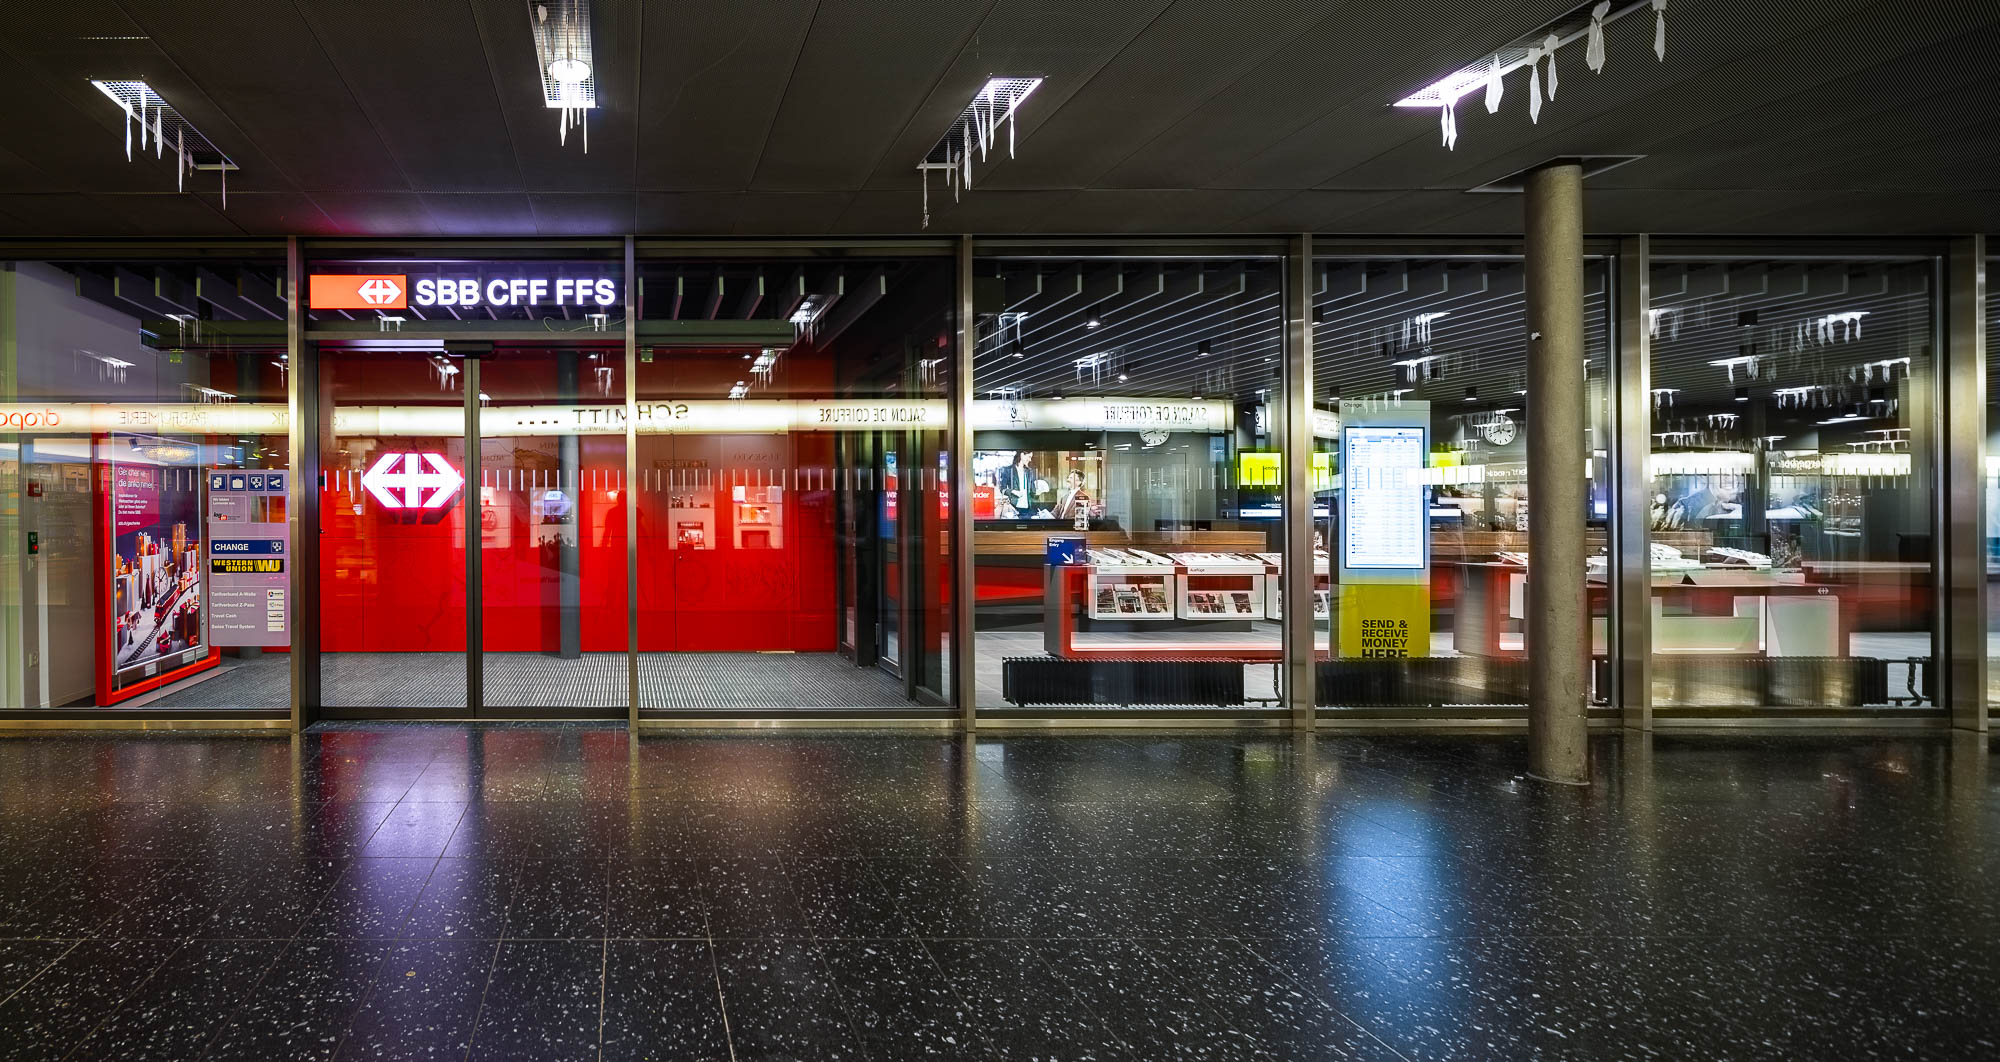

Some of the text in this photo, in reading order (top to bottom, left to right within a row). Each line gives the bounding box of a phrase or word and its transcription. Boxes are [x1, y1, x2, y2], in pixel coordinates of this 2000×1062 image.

[415, 278, 616, 306] SBB CFF FFS
[1361, 619, 1408, 628] SEND &
[1361, 629, 1409, 638] RECEIVE
[1361, 638, 1409, 648] MONEY
[1361, 648, 1409, 658] HERE
